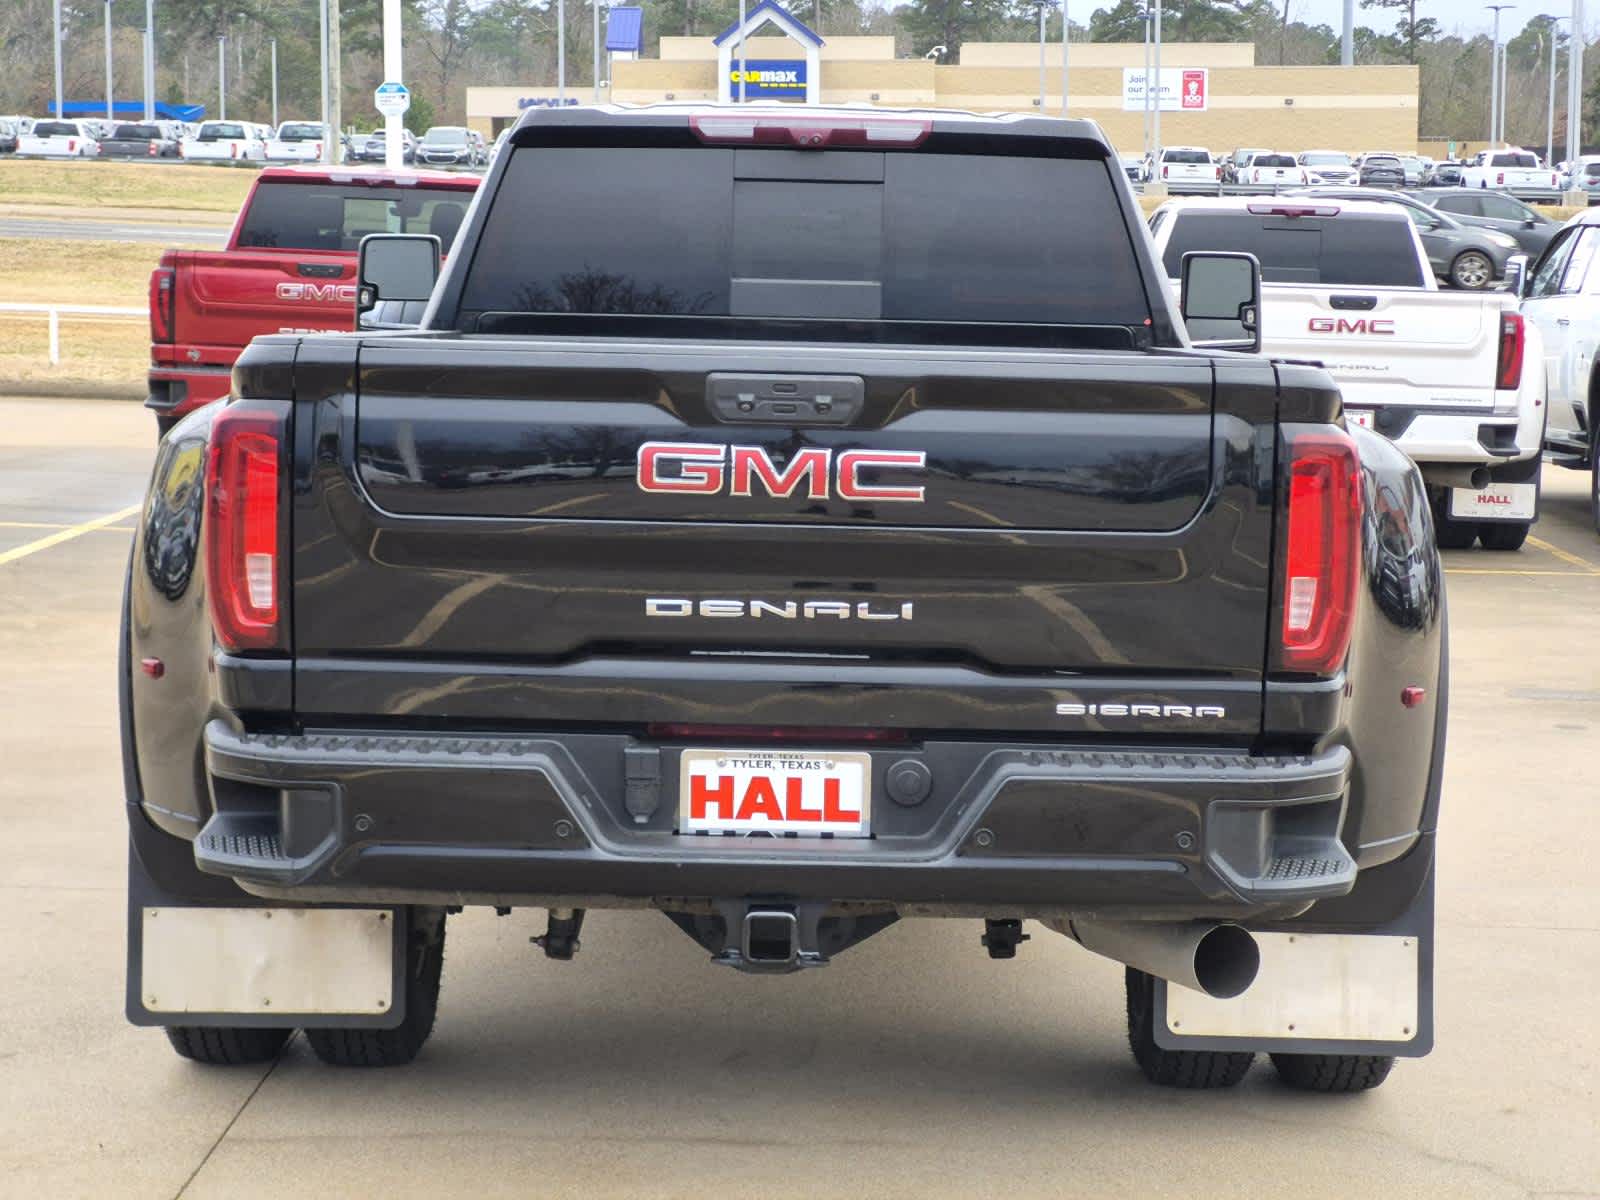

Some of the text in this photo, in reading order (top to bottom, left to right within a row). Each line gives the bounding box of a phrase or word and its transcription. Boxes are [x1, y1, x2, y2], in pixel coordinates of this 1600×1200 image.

[276, 283, 357, 301] GMC
[1308, 318, 1395, 335] GMC
[637, 441, 926, 501] GMC
[1477, 495, 1512, 504] HALL
[645, 598, 913, 620] DENALI
[1056, 704, 1225, 717] SIERRA
[733, 759, 821, 770] TYLER, TEXAS
[690, 775, 860, 823] HALL
